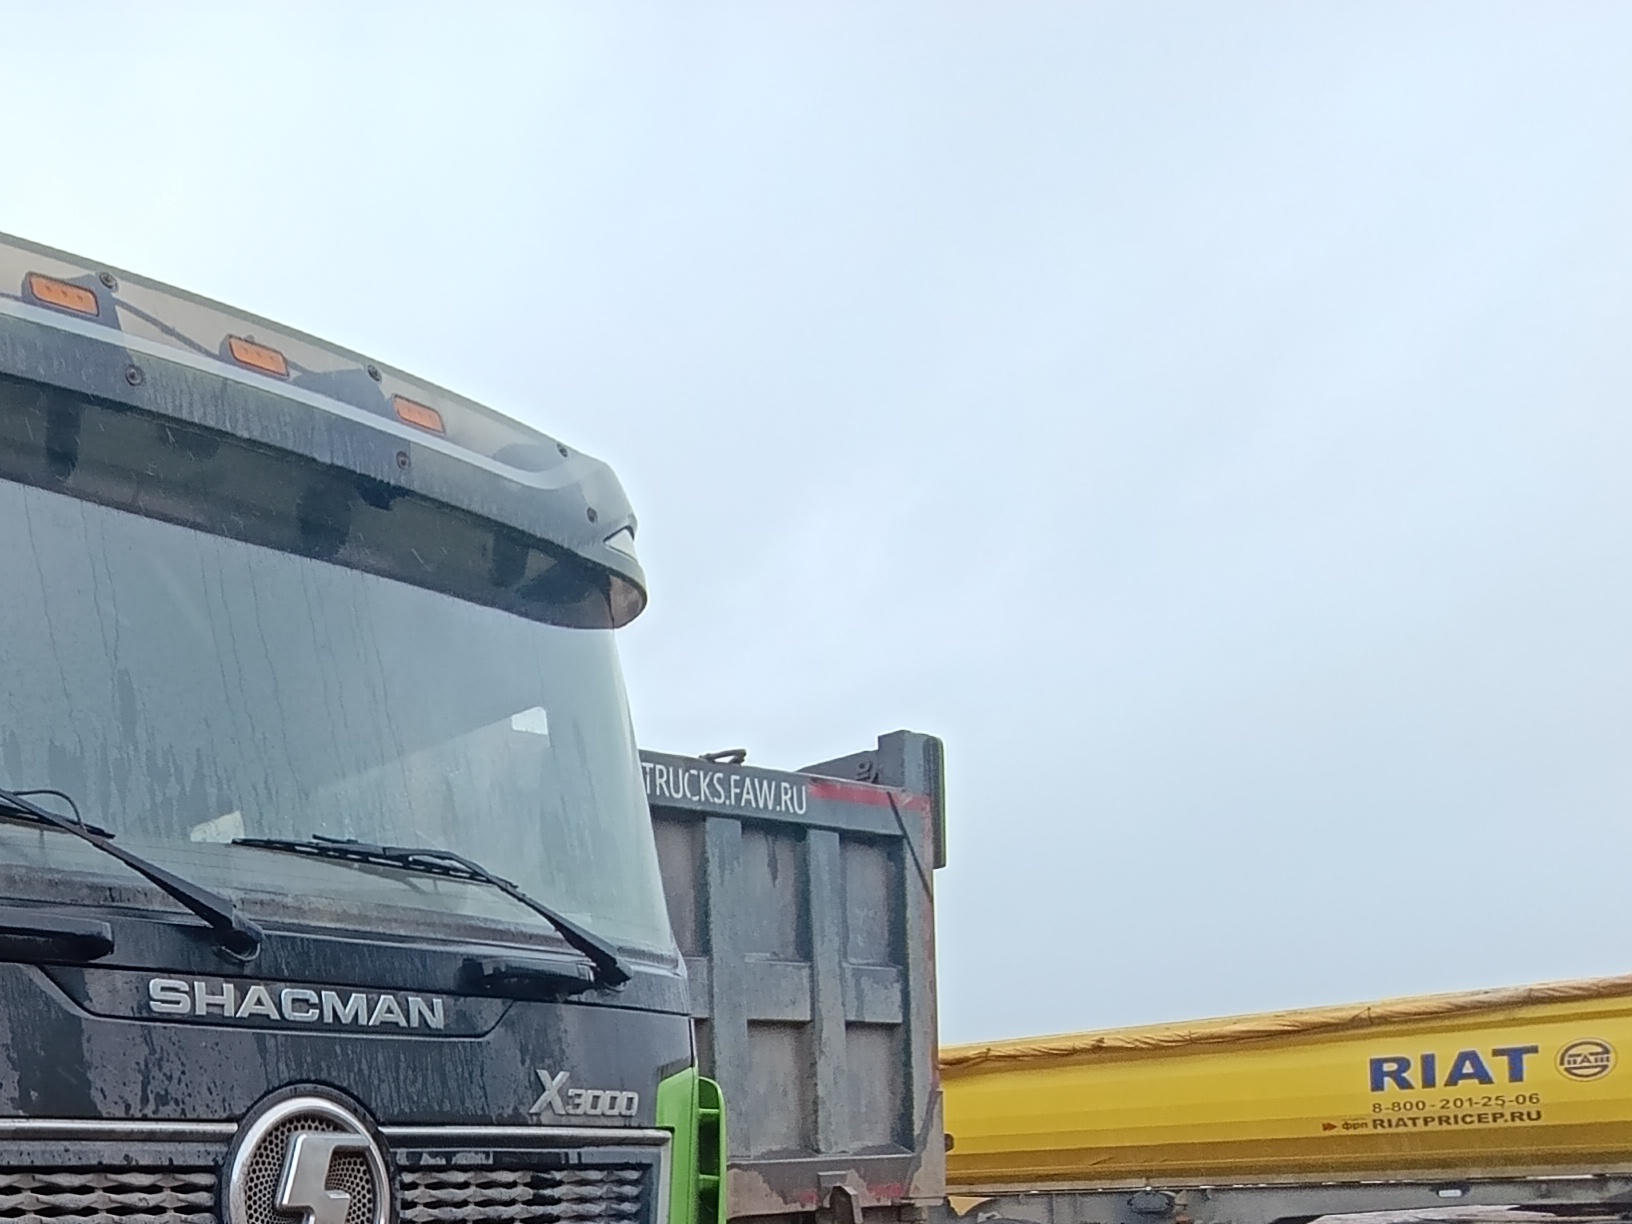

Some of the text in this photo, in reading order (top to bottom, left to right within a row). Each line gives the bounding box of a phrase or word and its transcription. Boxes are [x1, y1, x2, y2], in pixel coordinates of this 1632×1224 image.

[642, 762, 807, 815] TRUCKS.FAW.RU
[148, 977, 445, 1030] SHACMAN
[529, 1068, 640, 1117] X3000
[1369, 1044, 1540, 1093] RIAT
[1371, 1109, 1543, 1131] RIATPRICEP.RU
